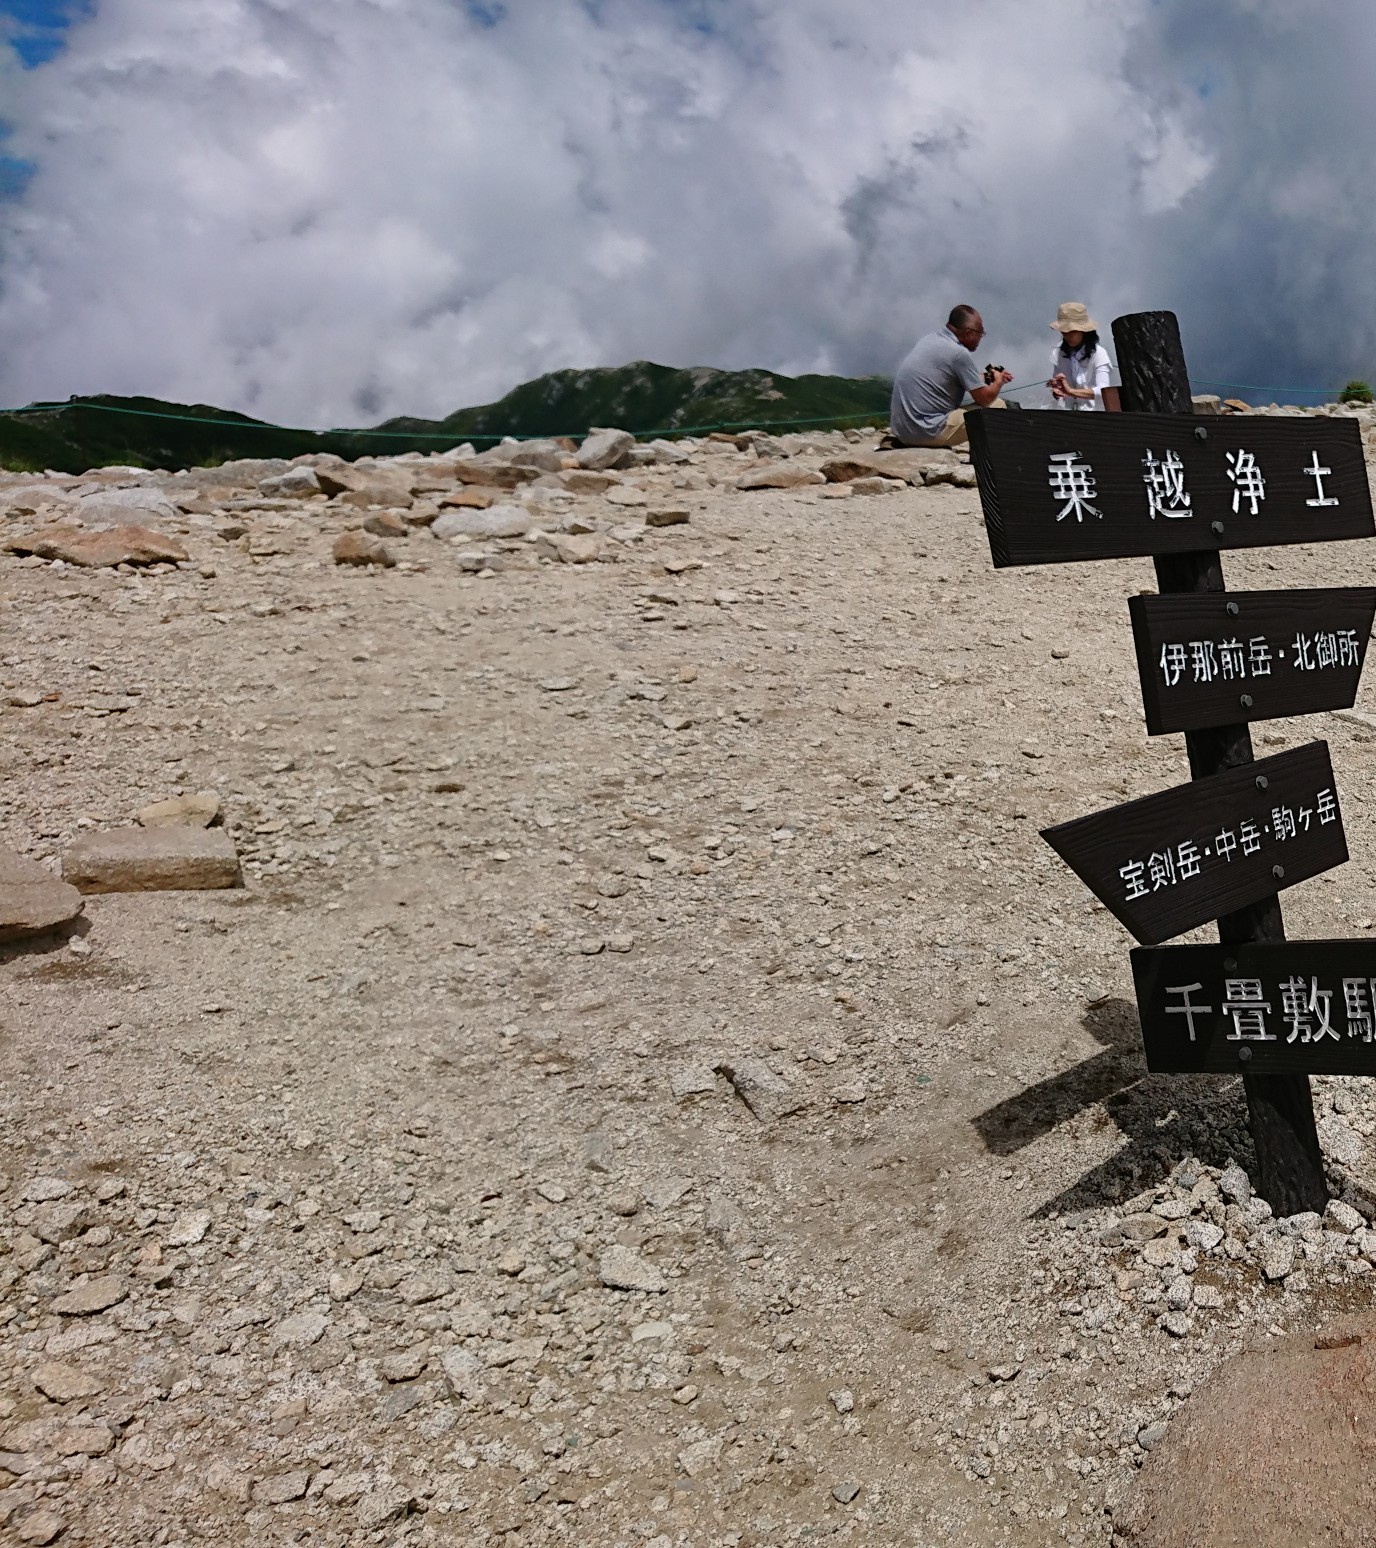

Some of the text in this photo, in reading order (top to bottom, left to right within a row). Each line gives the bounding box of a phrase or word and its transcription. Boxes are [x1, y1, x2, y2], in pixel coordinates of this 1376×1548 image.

[1047, 448, 1340, 522] 乗越浄土
[1158, 629, 1360, 687] 伊那前岳・北御所
